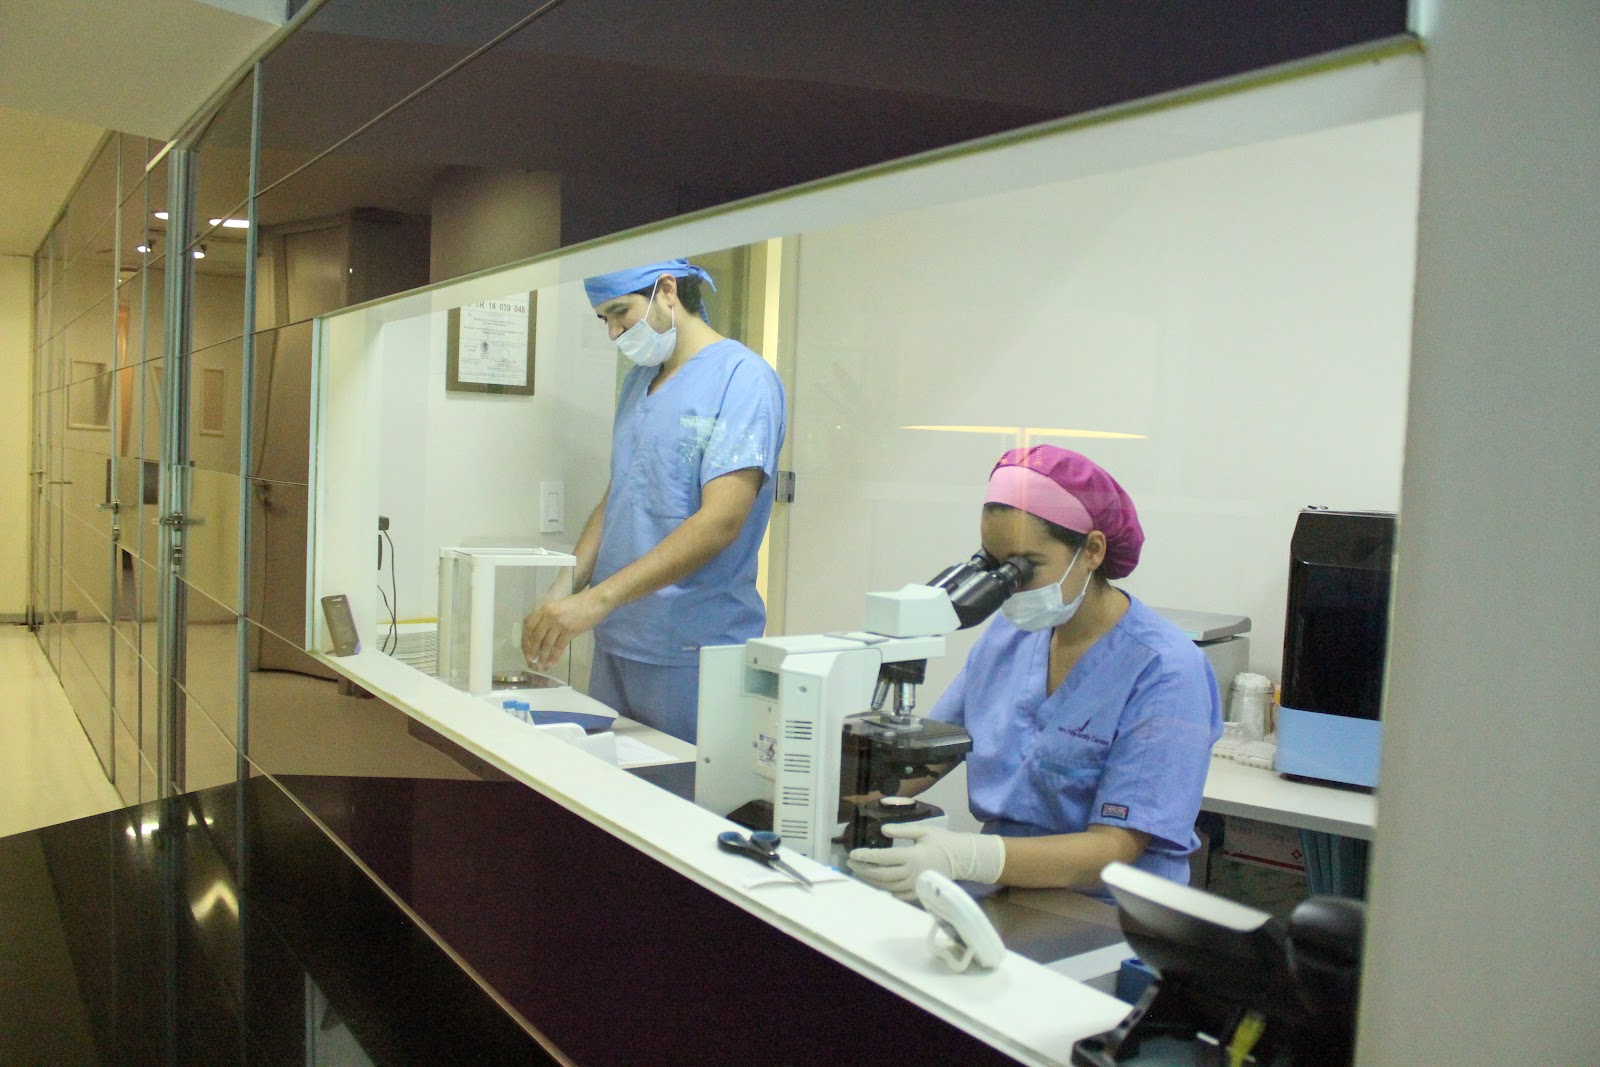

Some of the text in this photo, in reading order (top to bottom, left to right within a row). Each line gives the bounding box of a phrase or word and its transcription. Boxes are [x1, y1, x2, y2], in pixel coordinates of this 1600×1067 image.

[489, 302, 496, 310] 14
[499, 303, 511, 312] 039
[513, 305, 526, 314] 048
